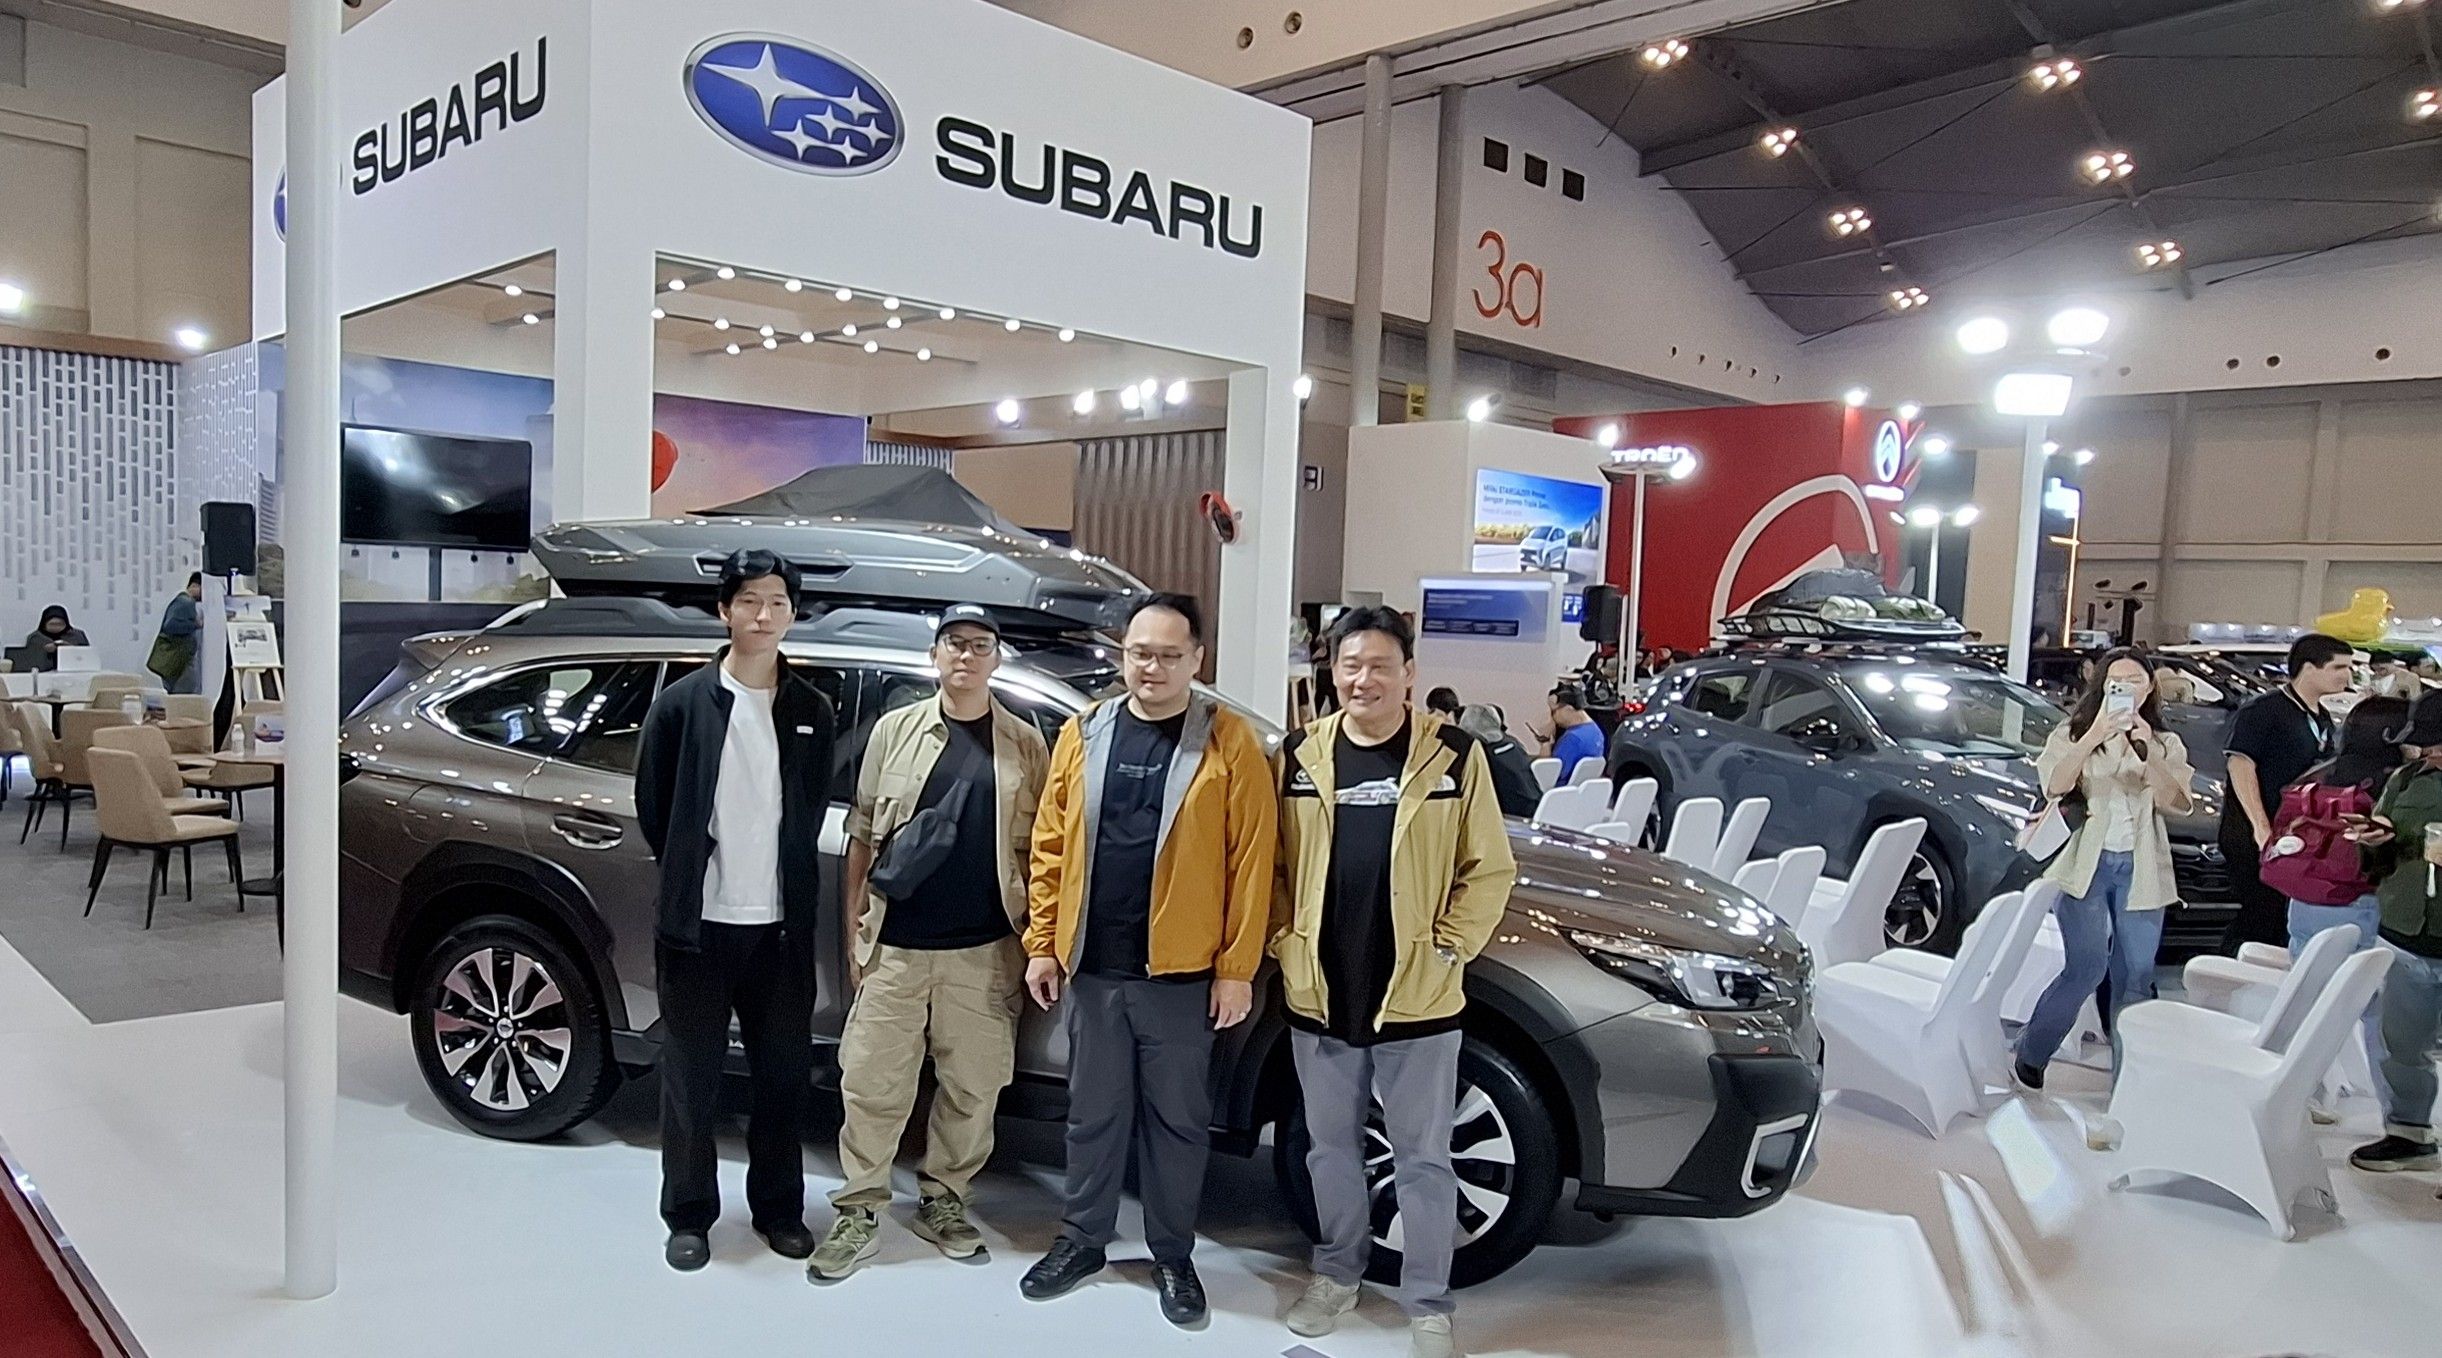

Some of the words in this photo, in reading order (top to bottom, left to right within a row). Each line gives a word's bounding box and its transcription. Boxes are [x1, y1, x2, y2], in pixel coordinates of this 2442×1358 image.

[353, 37, 547, 195] SUBARU
[935, 116, 1263, 259] SUBARU
[1472, 230, 1542, 328] 3a
